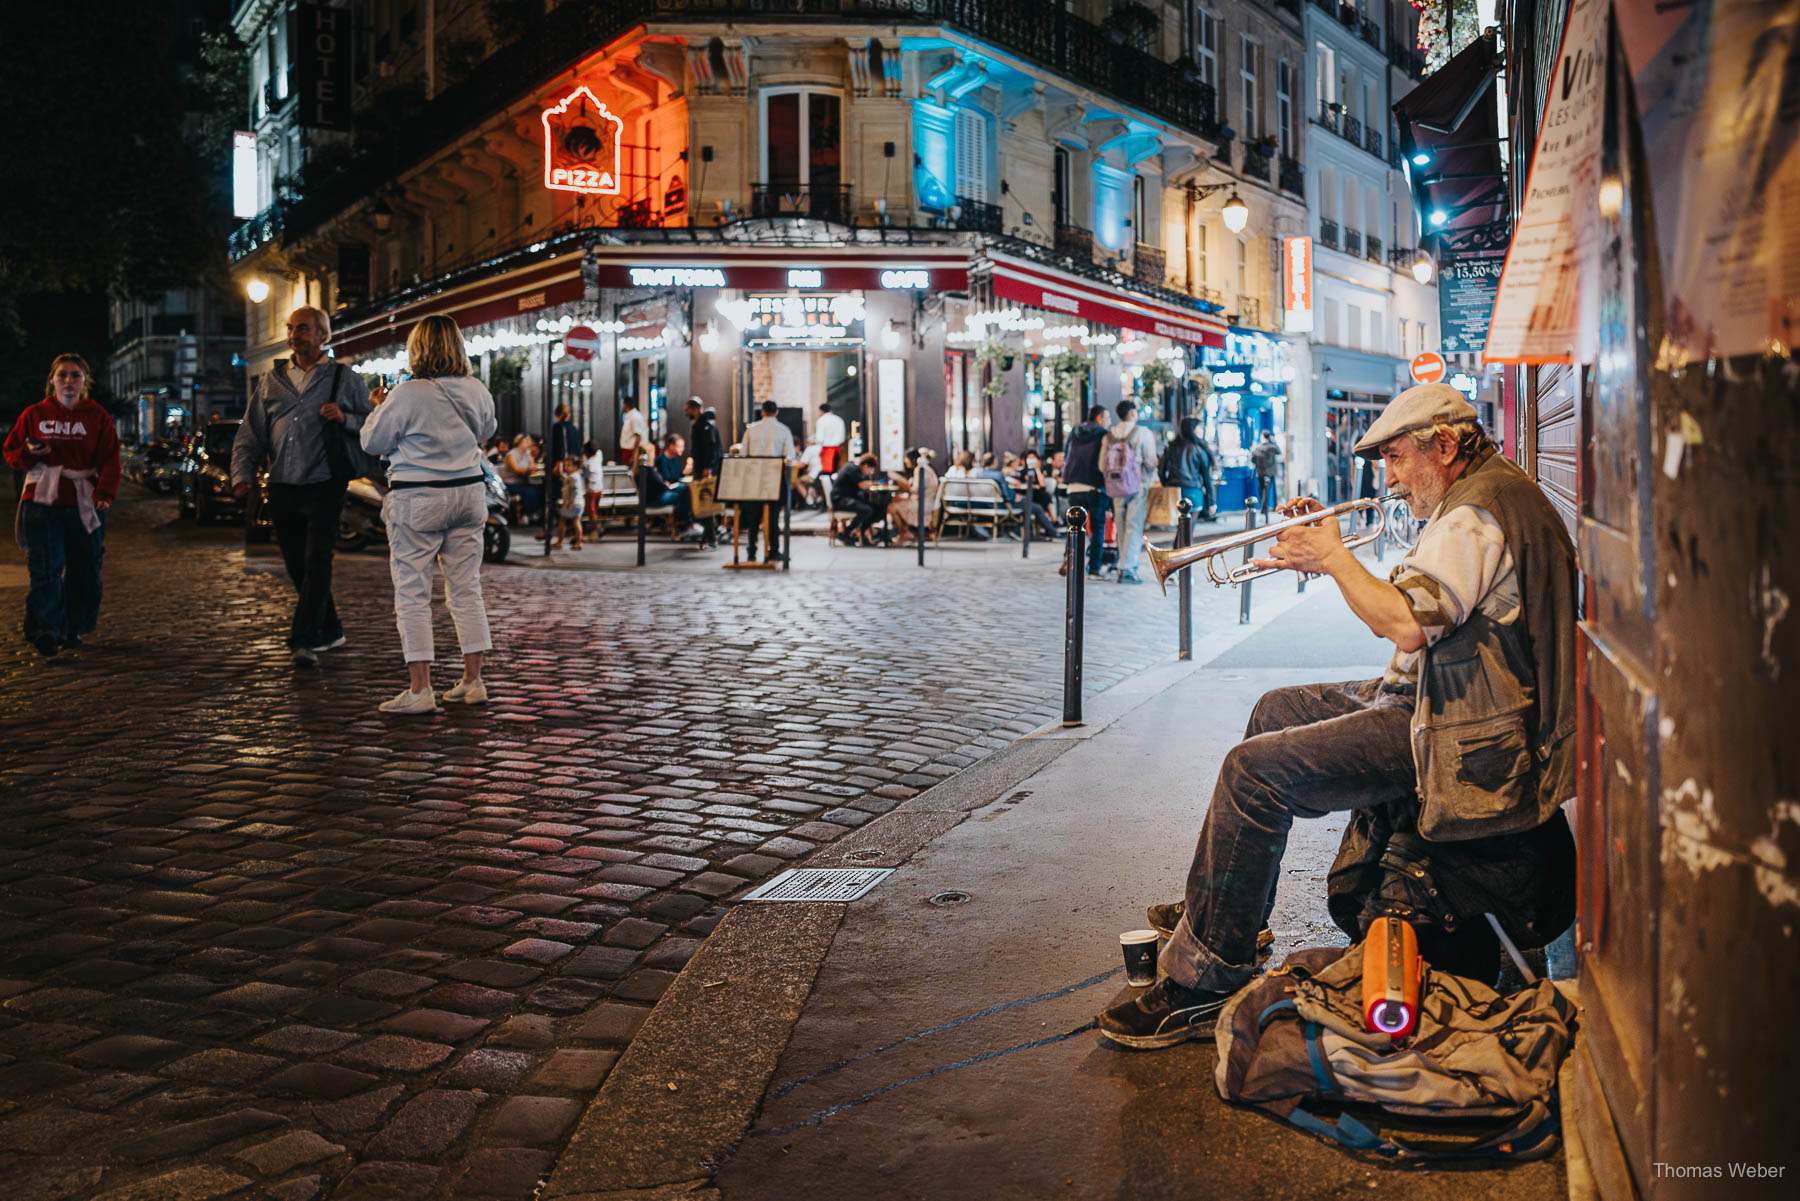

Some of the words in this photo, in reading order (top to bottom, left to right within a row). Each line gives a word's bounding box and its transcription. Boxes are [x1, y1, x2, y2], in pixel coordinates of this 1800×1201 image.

[315, 9, 337, 125] HOTEL
[553, 169, 614, 187] PIZZA
[39, 420, 87, 435] CNA
